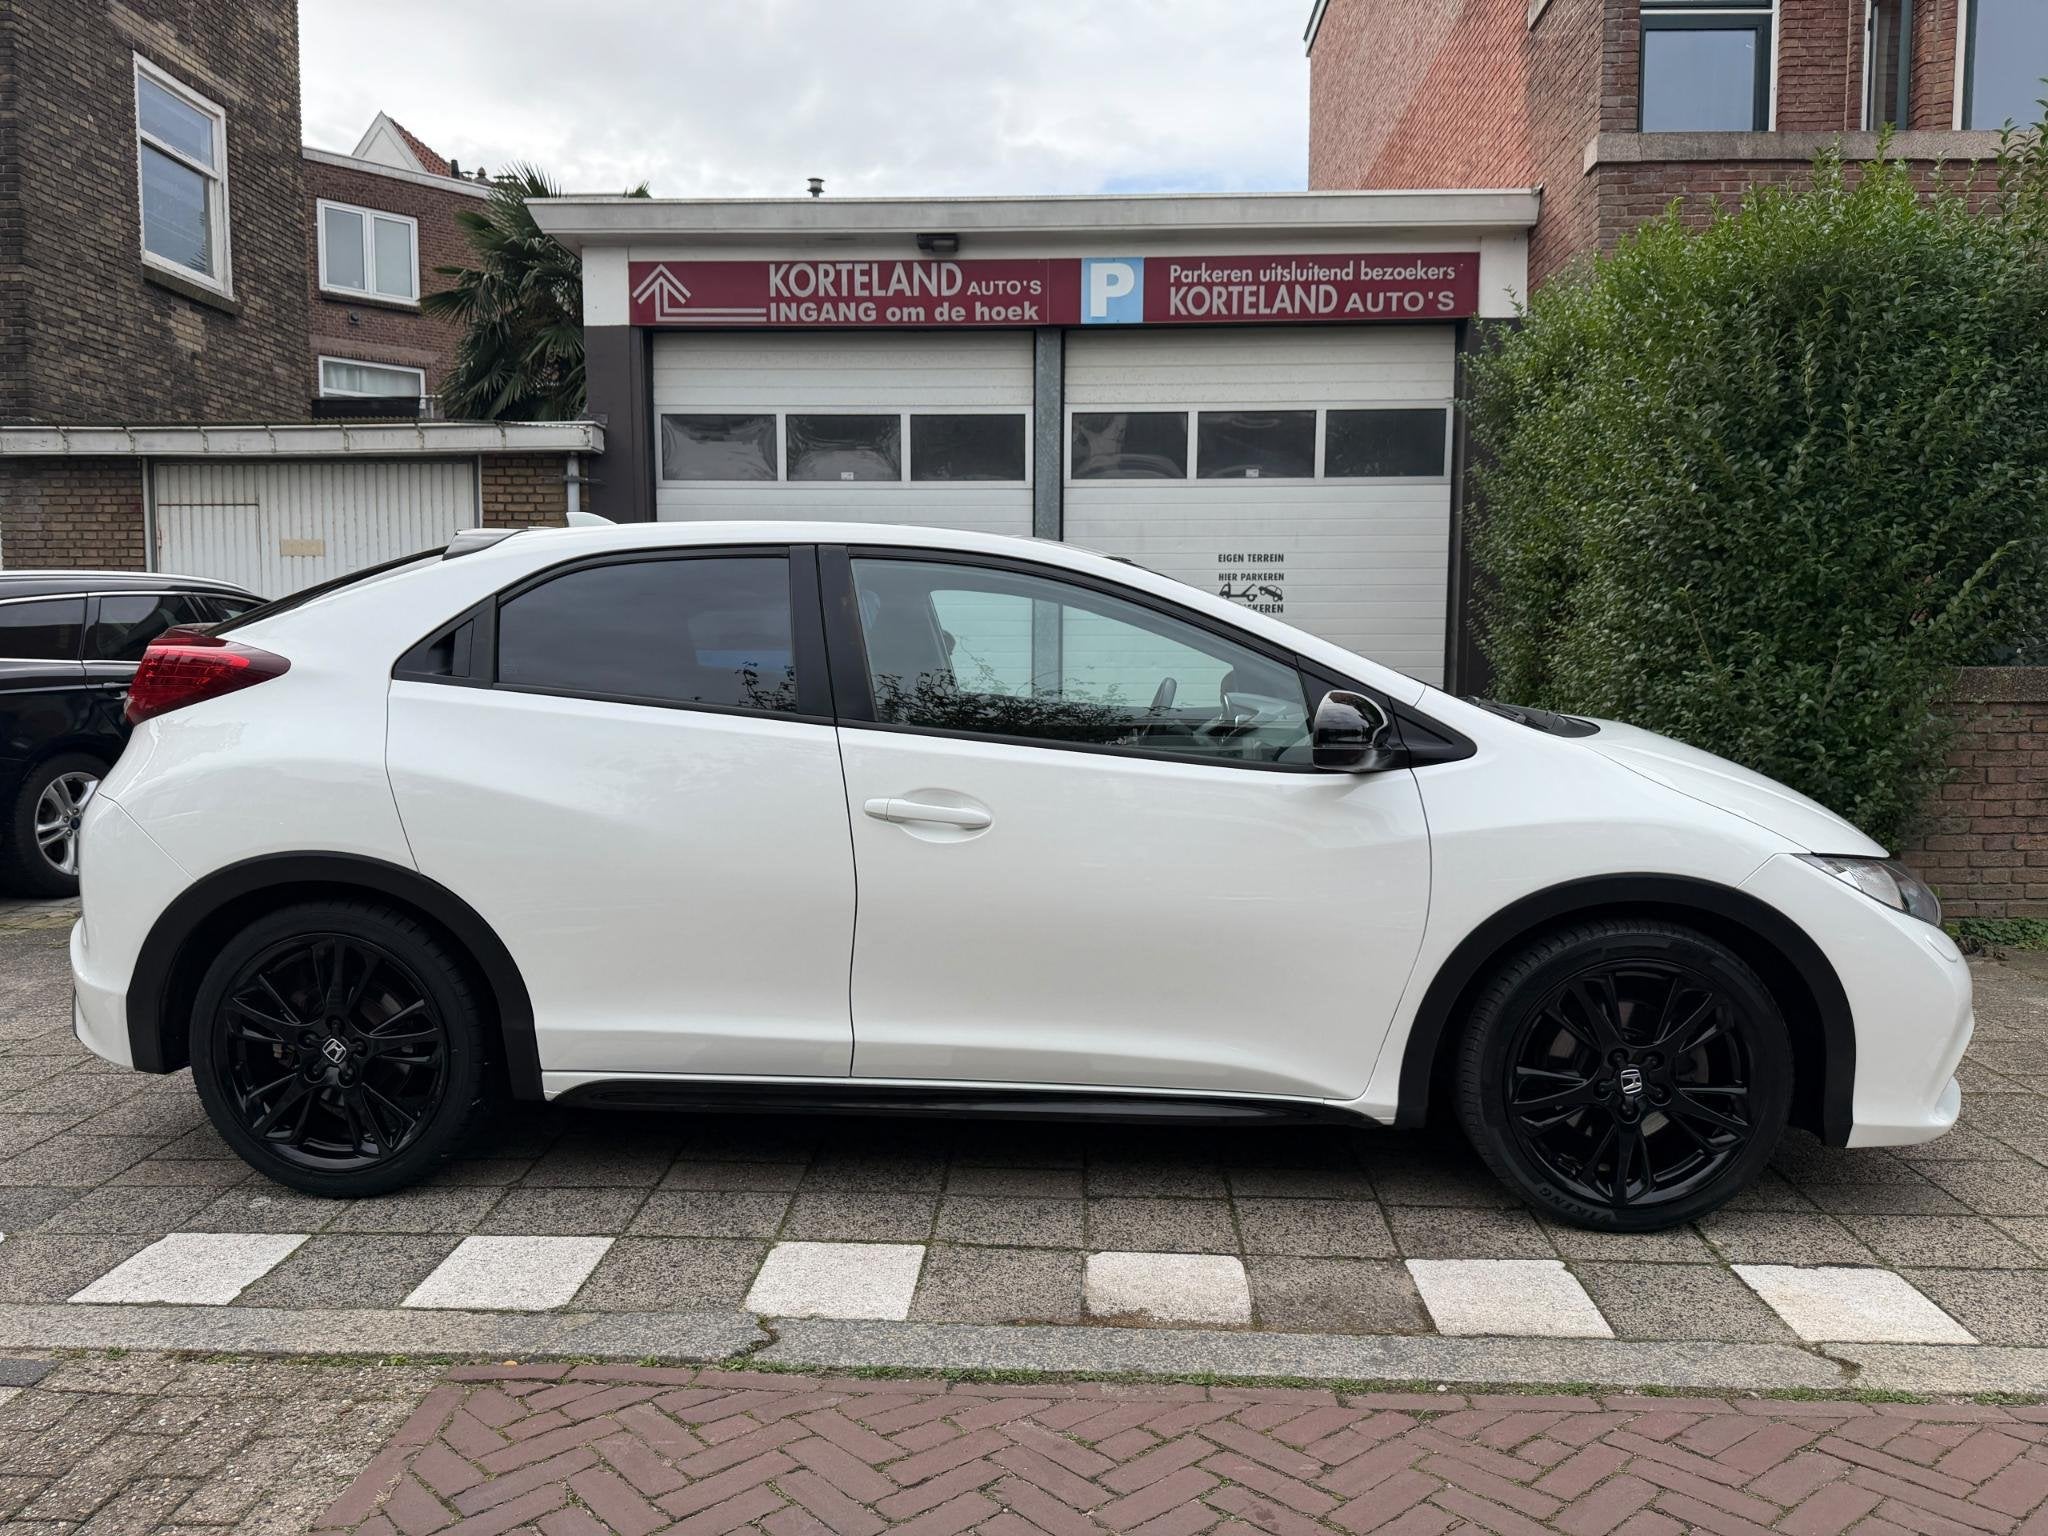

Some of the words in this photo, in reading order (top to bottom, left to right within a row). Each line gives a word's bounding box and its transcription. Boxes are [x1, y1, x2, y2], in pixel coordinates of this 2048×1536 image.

[769, 262, 963, 297] KORTELAND
[966, 279, 1042, 296] AUTO'S
[1169, 263, 1253, 283] Parkeren
[1259, 260, 1354, 282] uitsluitend
[1360, 259, 1456, 280] bezoekers
[1090, 262, 1135, 318] P
[1169, 284, 1338, 316] KORTELAND
[1344, 290, 1455, 313] AUTO'S
[769, 301, 877, 322] INGANG
[885, 306, 925, 322] om
[934, 301, 966, 322] de
[974, 301, 1040, 321] hoek
[1218, 553, 1244, 563] EIGEN
[1247, 553, 1284, 563] TERREIN
[1218, 572, 1238, 581] HIER
[1240, 572, 1284, 581] PARKEREN
[1244, 603, 1284, 613] KEREN
